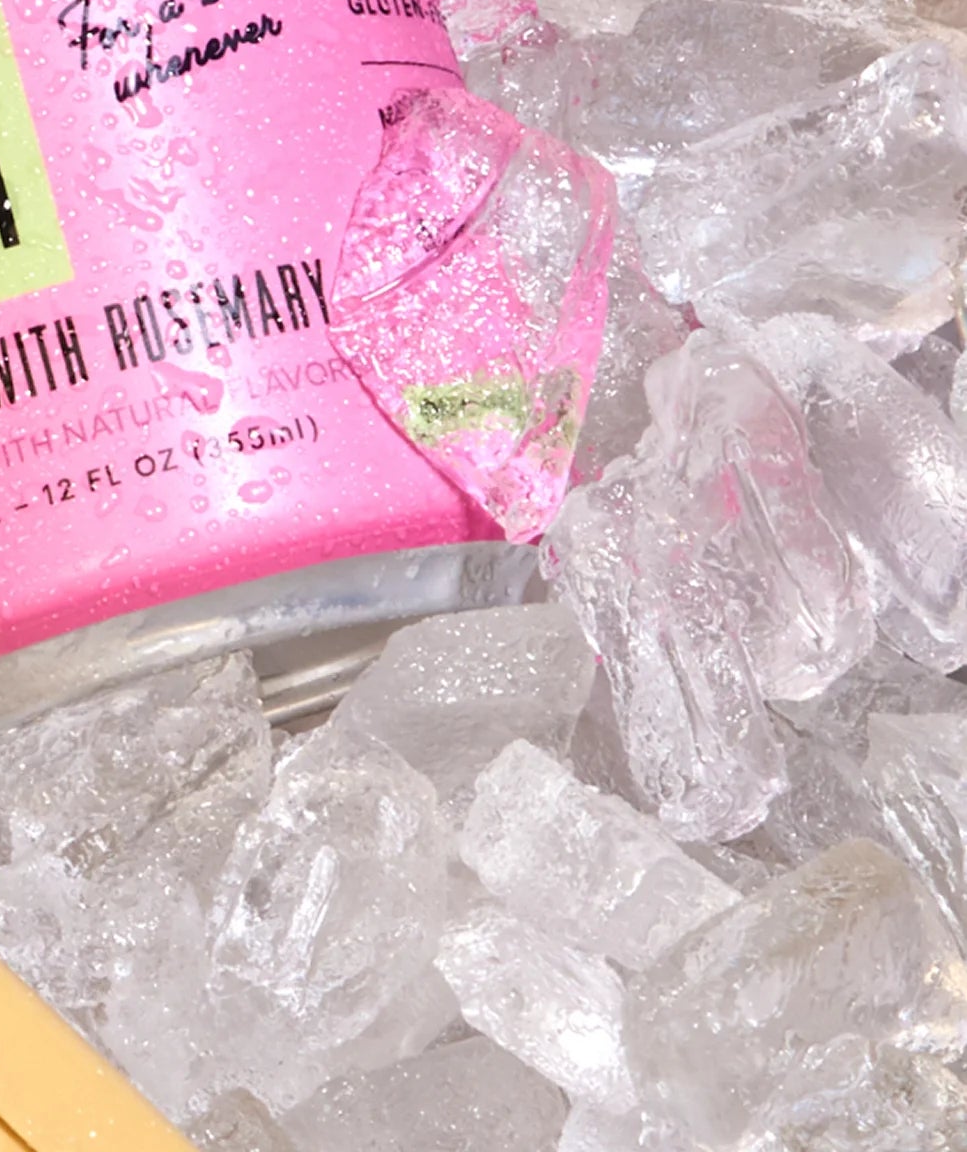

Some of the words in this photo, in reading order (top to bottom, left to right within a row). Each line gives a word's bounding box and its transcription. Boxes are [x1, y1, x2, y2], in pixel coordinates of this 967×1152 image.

[113, 13, 283, 103] whenever
[103, 258, 331, 372] ROSEMARY
[42, 477, 76, 506] 12
[86, 464, 122, 492] FL
[134, 447, 179, 478] OZ
[192, 414, 320, 467] (355ml)
[63, 390, 219, 445] NATURAL
